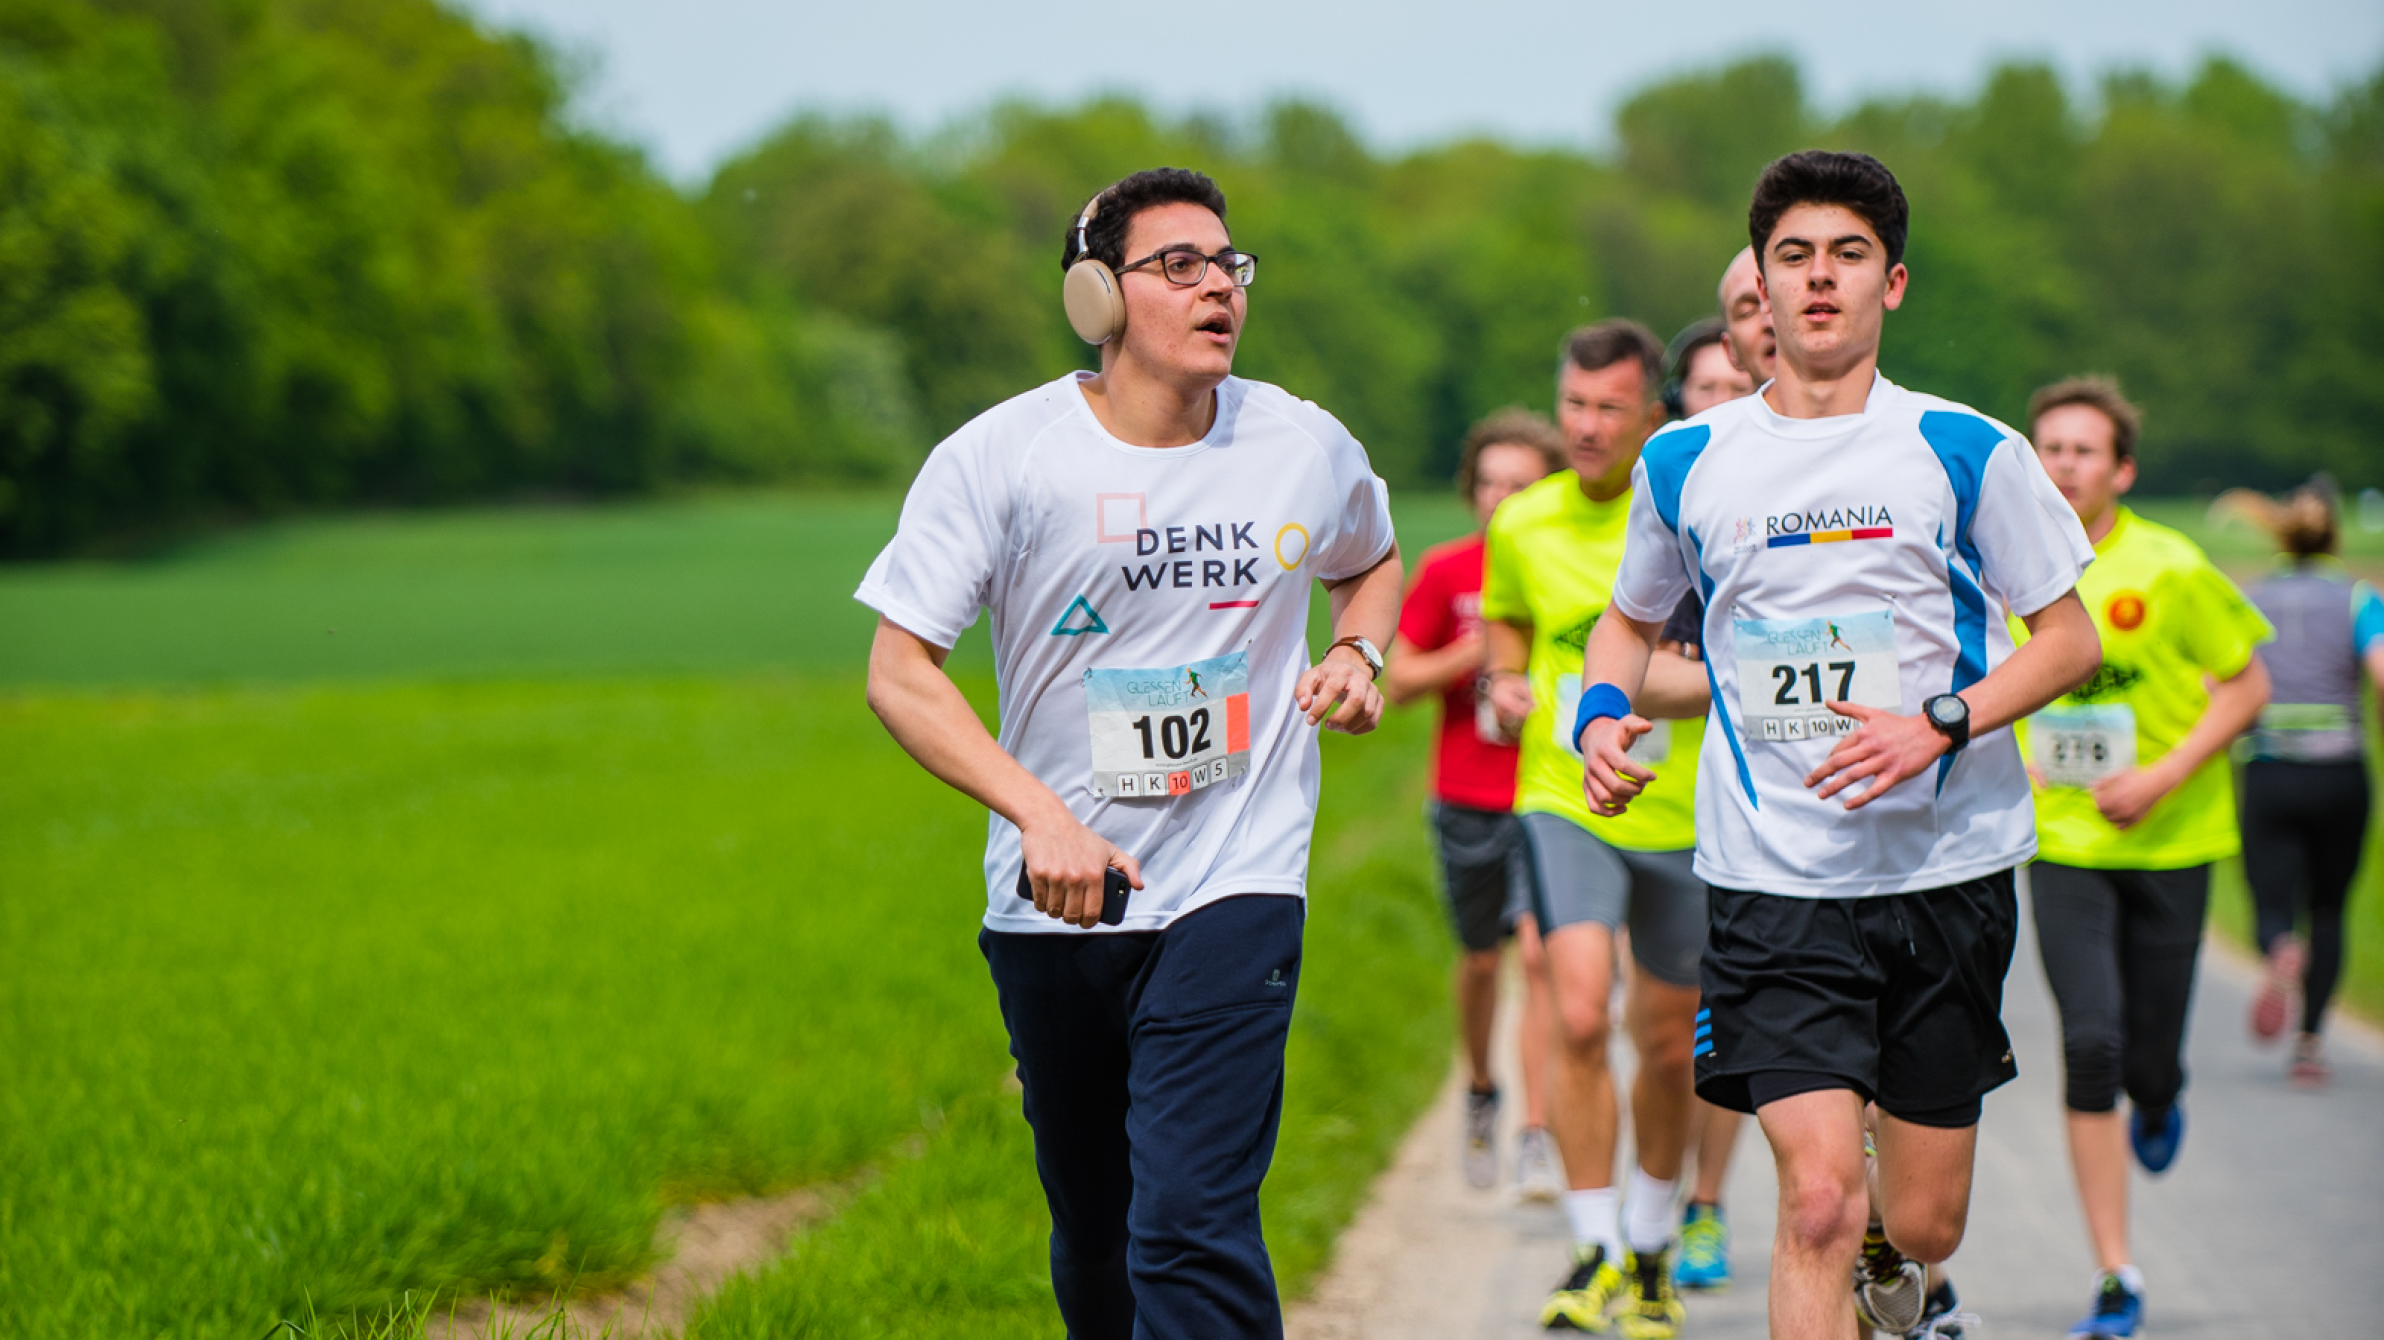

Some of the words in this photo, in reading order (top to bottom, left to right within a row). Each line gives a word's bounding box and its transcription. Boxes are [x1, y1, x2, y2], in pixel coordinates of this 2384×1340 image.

[1766, 505, 1893, 535] ROMANIA
[1136, 521, 1260, 556] DENK
[1122, 557, 1260, 591] WERK
[1127, 679, 1181, 694] GLESSEN
[1772, 660, 1855, 705] 217
[1132, 707, 1211, 759] 102
[1766, 722, 1777, 735] H
[1788, 721, 1799, 735] K
[1812, 720, 1828, 732] 10
[1835, 717, 1851, 730] W
[1121, 777, 1134, 791] H
[1149, 776, 1160, 790] K
[1172, 775, 1188, 789] 10
[1194, 768, 1206, 783] W
[1215, 763, 1223, 776] 5
